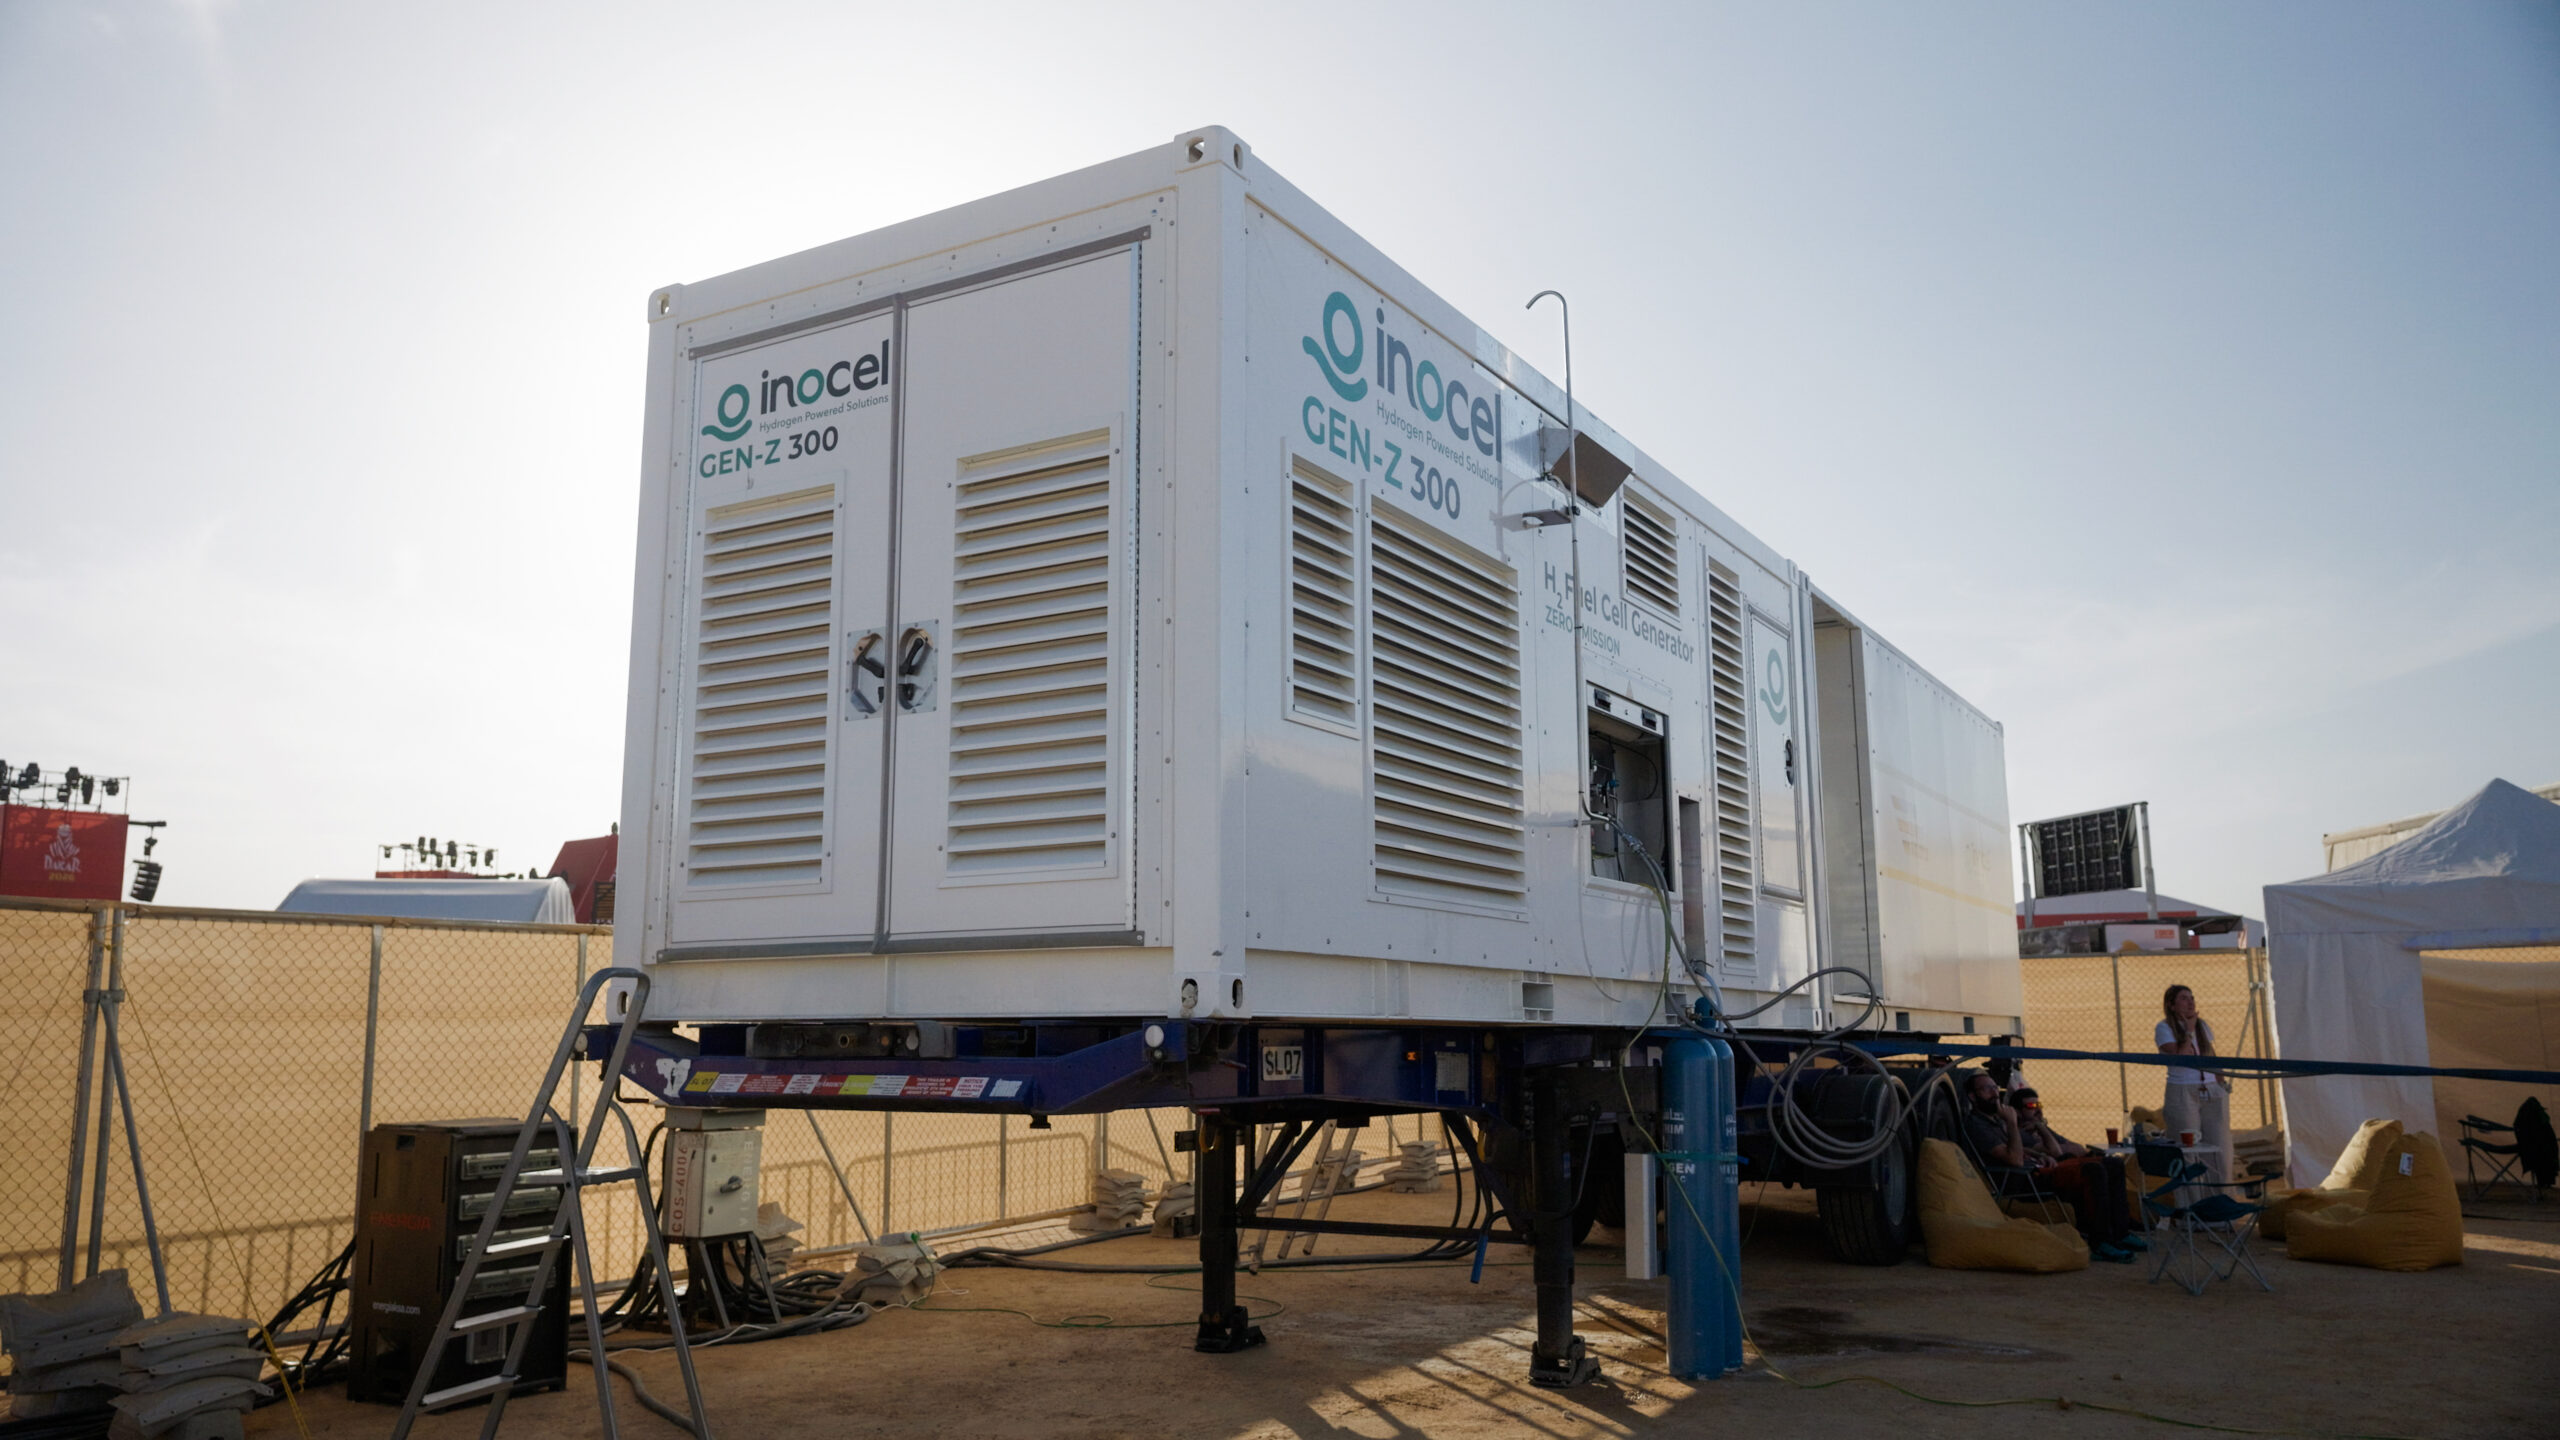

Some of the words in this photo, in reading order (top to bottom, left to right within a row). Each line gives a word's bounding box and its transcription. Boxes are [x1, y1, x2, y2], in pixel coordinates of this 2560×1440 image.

[761, 339, 889, 415] inocel
[1375, 307, 1502, 464] inocel
[759, 414, 803, 432] Hydrogen
[804, 403, 845, 422] Powered
[846, 394, 890, 412] Solutions
[1377, 400, 1424, 440] Hydrogen
[1425, 429, 1466, 467] Powered
[699, 438, 782, 479] GEN-Z
[787, 425, 839, 460] 300
[1302, 395, 1403, 491] GEN-Z
[1409, 455, 1461, 521] 300
[1544, 604, 1573, 633] ZERO
[1578, 623, 1621, 656] MISSION
[1601, 594, 1628, 631] Cell
[1631, 610, 1695, 665] Generator
[1265, 1056, 1302, 1076] SL07
